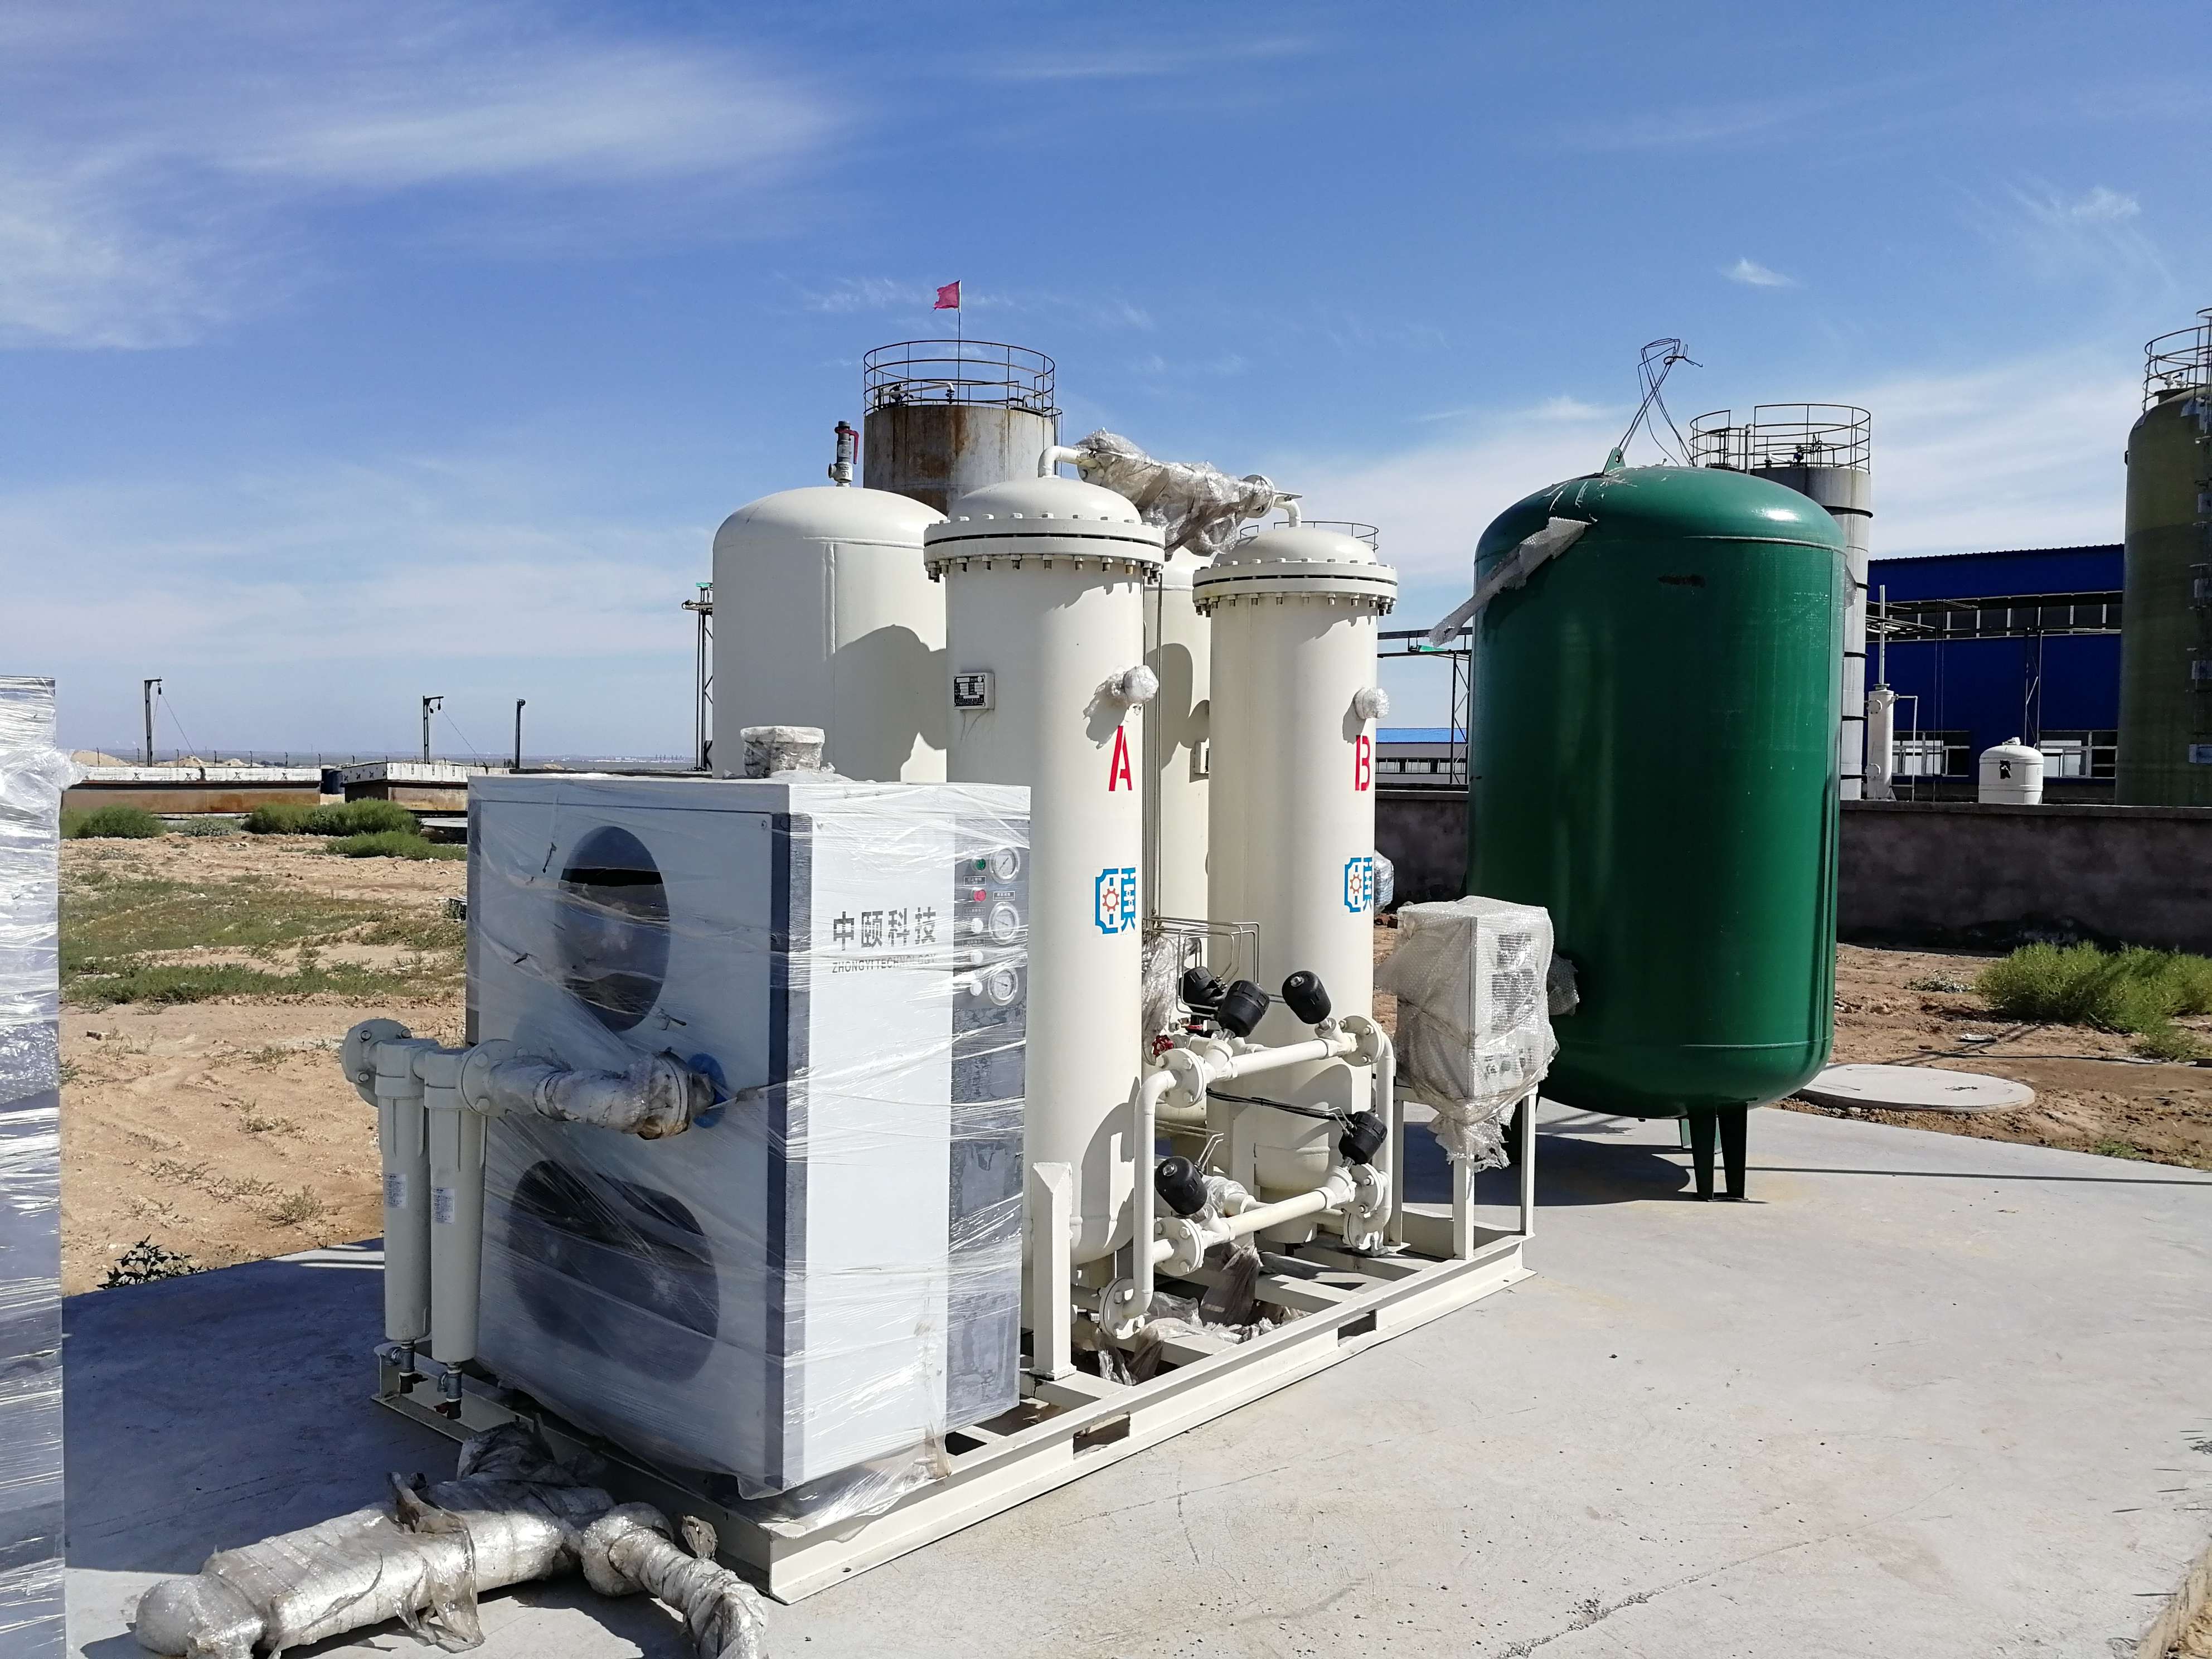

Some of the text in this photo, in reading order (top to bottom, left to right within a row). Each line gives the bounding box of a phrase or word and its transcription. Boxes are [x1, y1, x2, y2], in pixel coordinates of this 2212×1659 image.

[1109, 725, 1132, 792] A
[1355, 735, 1370, 791] B
[833, 906, 937, 951] 中颐科技
